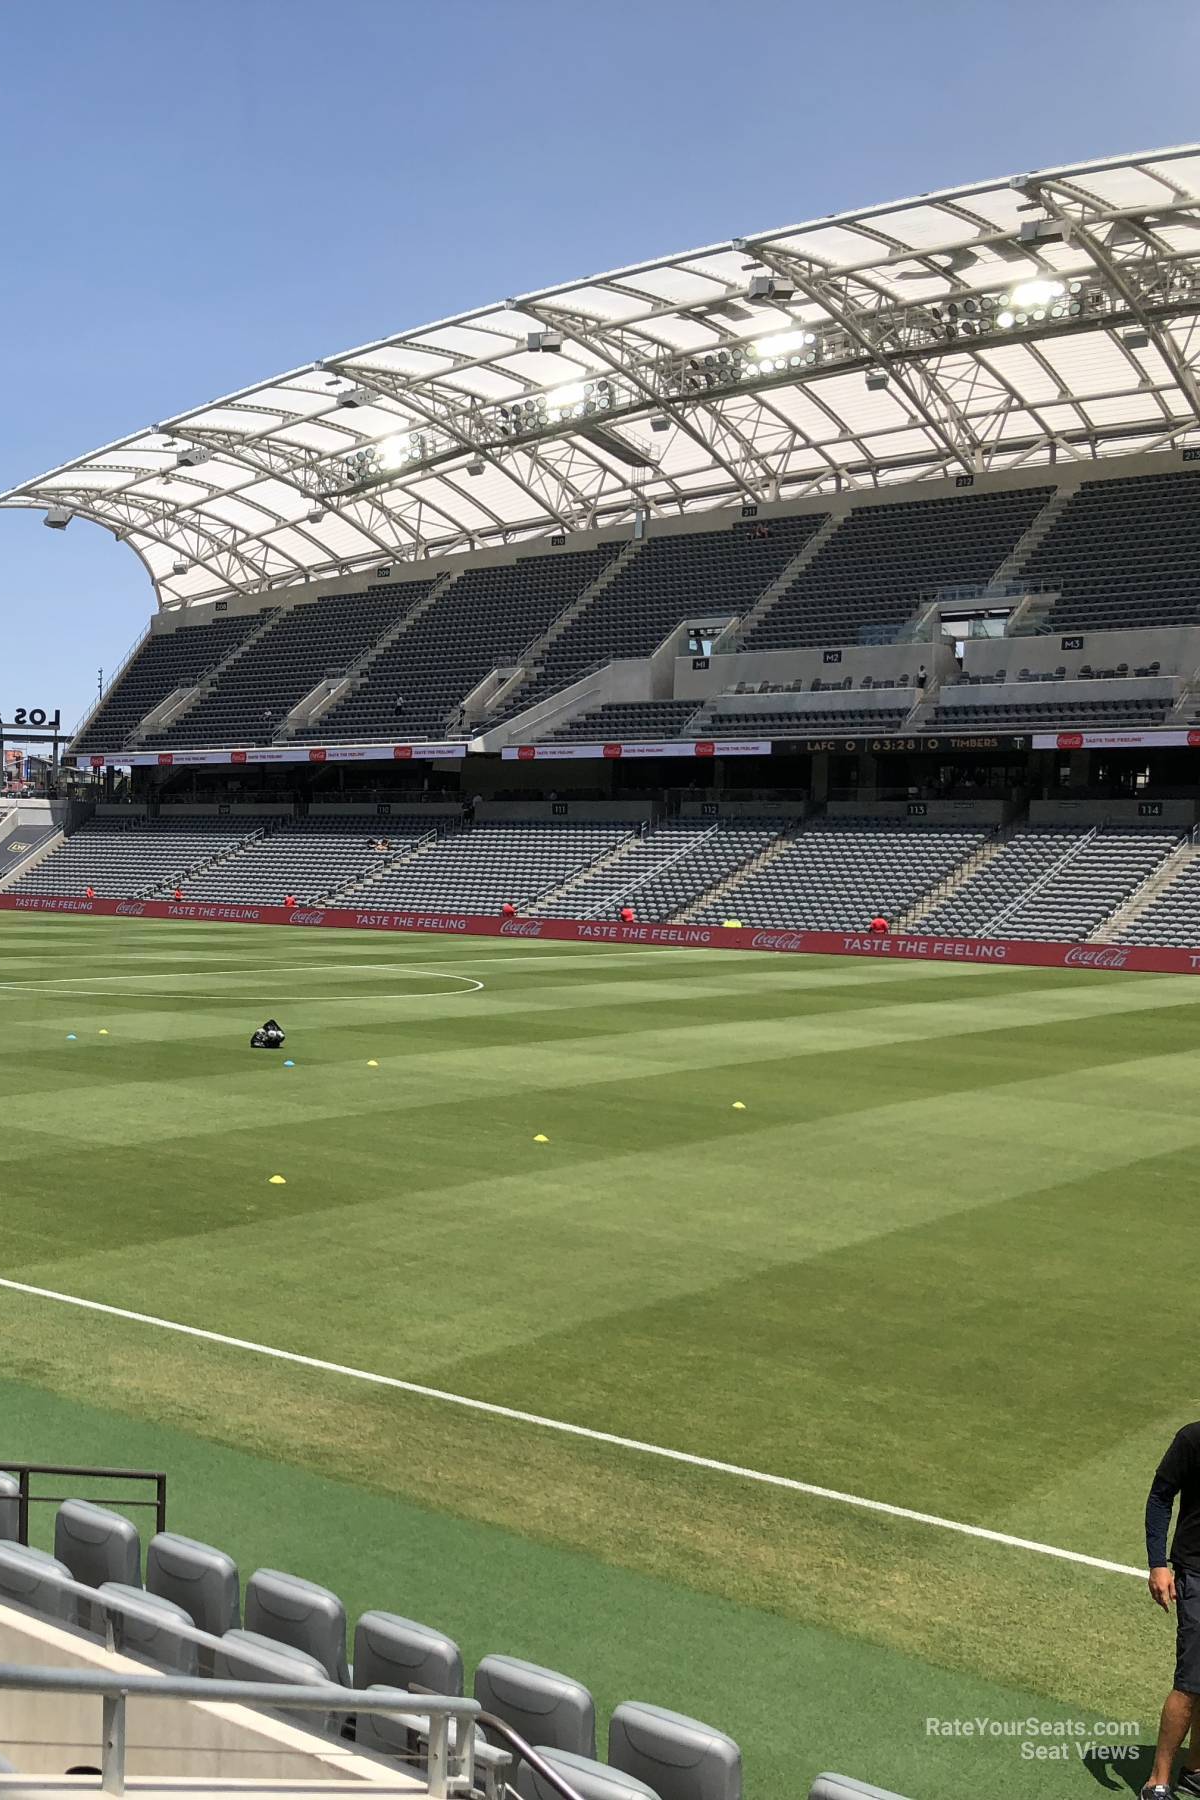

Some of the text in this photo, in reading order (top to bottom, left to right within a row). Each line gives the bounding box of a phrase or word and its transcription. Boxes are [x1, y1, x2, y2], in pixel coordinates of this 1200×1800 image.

[1064, 640, 1081, 649] M3
[826, 654, 838, 663] M2
[806, 741, 835, 751] LAFC
[872, 739, 915, 751] 63:28
[950, 738, 998, 748] TIMBERS
[554, 805, 566, 814] 111
[703, 805, 717, 814] 112
[909, 806, 924, 814] 113
[1142, 805, 1159, 814] 114
[15, 898, 93, 911] TASTE THE FEELING
[167, 905, 260, 919] TASTE THE FEELING
[289, 910, 325, 924] Coca-Cola
[355, 914, 467, 930] TASTE THE FEELING
[499, 919, 544, 936] Coca-Cola
[577, 925, 711, 943] TASTE THE FEELING
[751, 931, 804, 950] Coca-Cola
[842, 938, 1007, 958] TASTE THE FEELING
[1064, 946, 1132, 967] Coca-Cola
